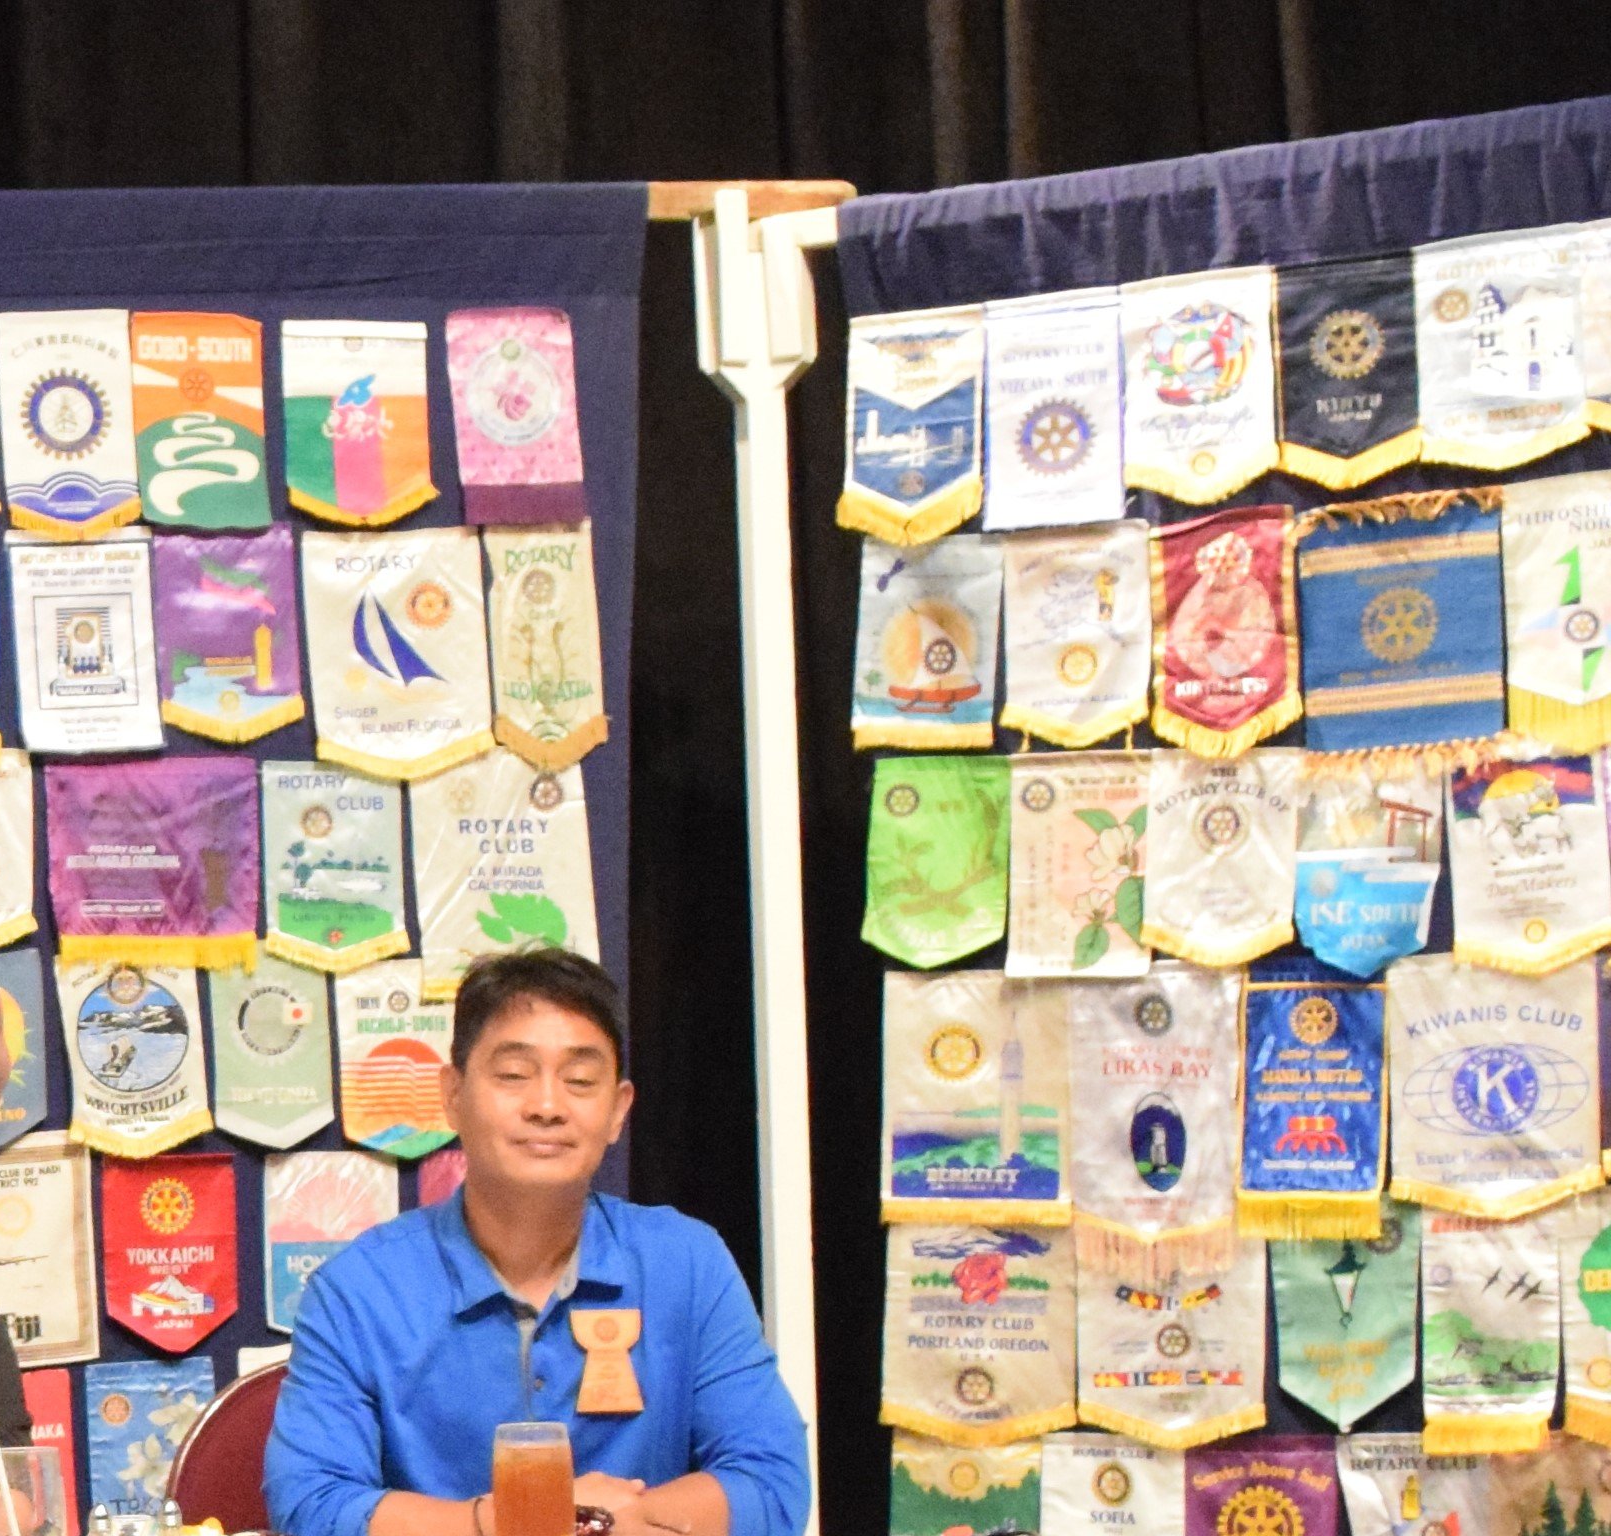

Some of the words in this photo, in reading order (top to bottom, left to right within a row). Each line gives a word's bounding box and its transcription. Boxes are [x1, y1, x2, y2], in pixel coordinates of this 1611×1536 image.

[1487, 402, 1564, 420] MISSION
[335, 554, 416, 573] ROTARY
[334, 707, 378, 719] SINGER
[407, 719, 462, 732] FLORIDA
[277, 774, 347, 790] ROTARY
[336, 795, 385, 811] CLUB
[1154, 782, 1221, 815] ROTARY
[1224, 783, 1266, 800] CLUB
[457, 819, 549, 835] ROTARY
[478, 839, 535, 854] CLUB
[492, 866, 544, 878] MIRADA
[468, 878, 545, 891] CALIFORNIA
[1309, 900, 1354, 925] ISE
[1404, 1003, 1508, 1040] KIWANIS
[1518, 1005, 1583, 1032] CLUB
[1102, 1060, 1165, 1077] LIKAS
[1169, 1062, 1214, 1078] BAY
[1476, 1064, 1517, 1116] K
[84, 1085, 190, 1116] WRIGHTSVILLE
[0, 1168, 20, 1178] CLUB
[24, 1167, 35, 1177] OF
[39, 1165, 61, 1175] NADI
[926, 1168, 1020, 1184] BERKELEY
[23, 1178, 38, 1187] 992
[125, 1245, 215, 1266] YOKKAICHI
[154, 1318, 194, 1329] JAPAN
[922, 1316, 985, 1330] ROTARY
[991, 1316, 1035, 1330] CLUB
[907, 1335, 985, 1350] PORTLAND
[989, 1335, 1050, 1352] OREGON
[1351, 1457, 1421, 1470] ROTARY
[1426, 1457, 1478, 1470] CLUB
[1090, 1511, 1136, 1524] SOFIA
